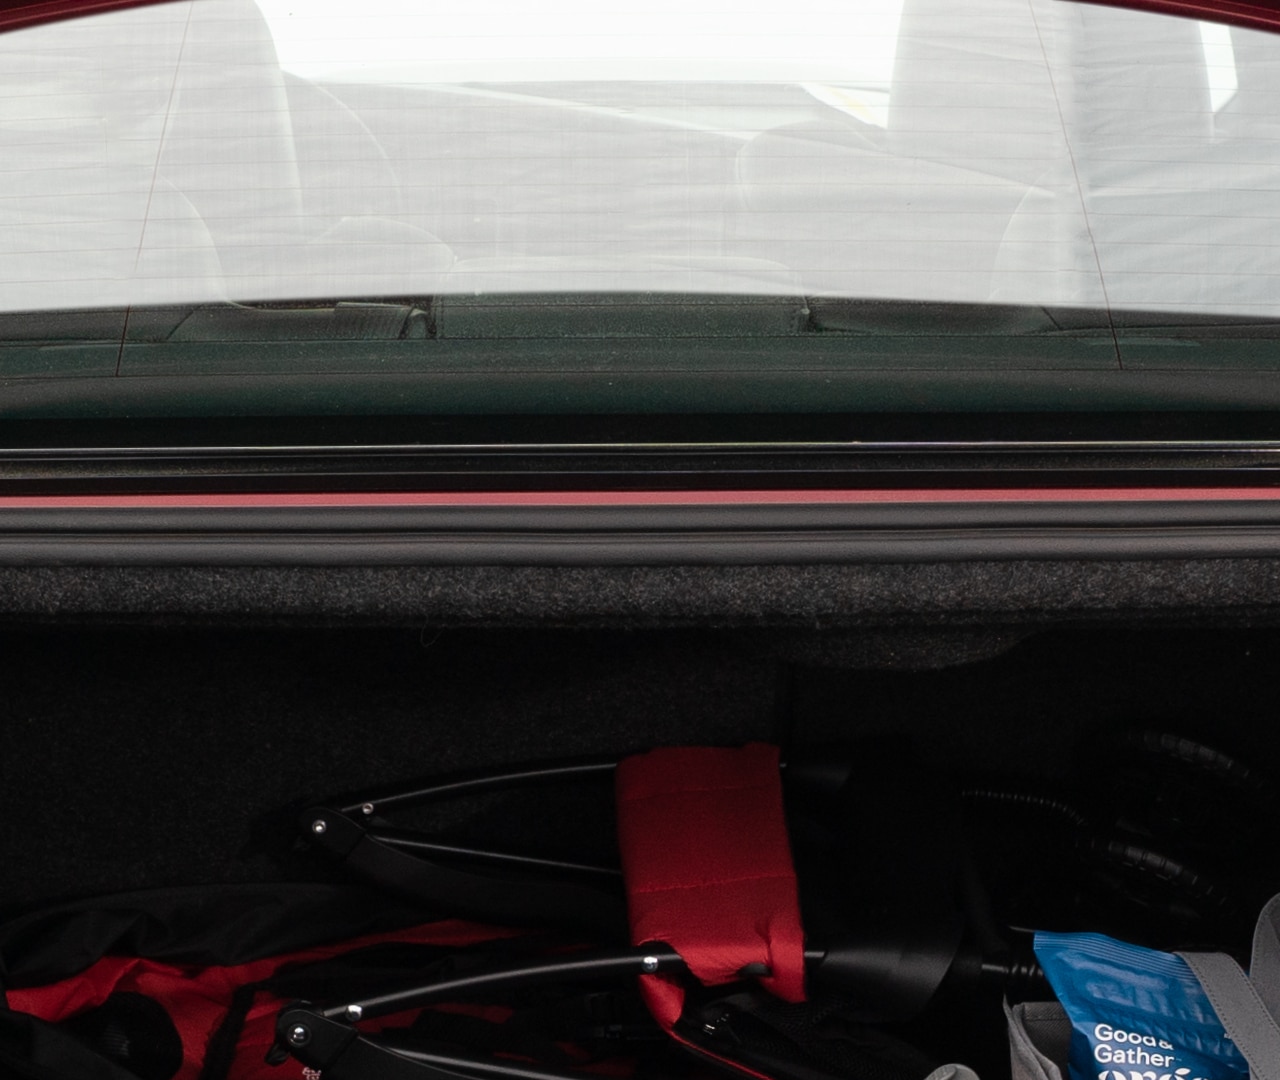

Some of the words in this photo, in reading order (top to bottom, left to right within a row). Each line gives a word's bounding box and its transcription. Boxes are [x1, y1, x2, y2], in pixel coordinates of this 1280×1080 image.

[1094, 1023, 1156, 1047] Good
[1158, 1039, 1174, 1050] &
[1094, 1043, 1175, 1068] Gather
